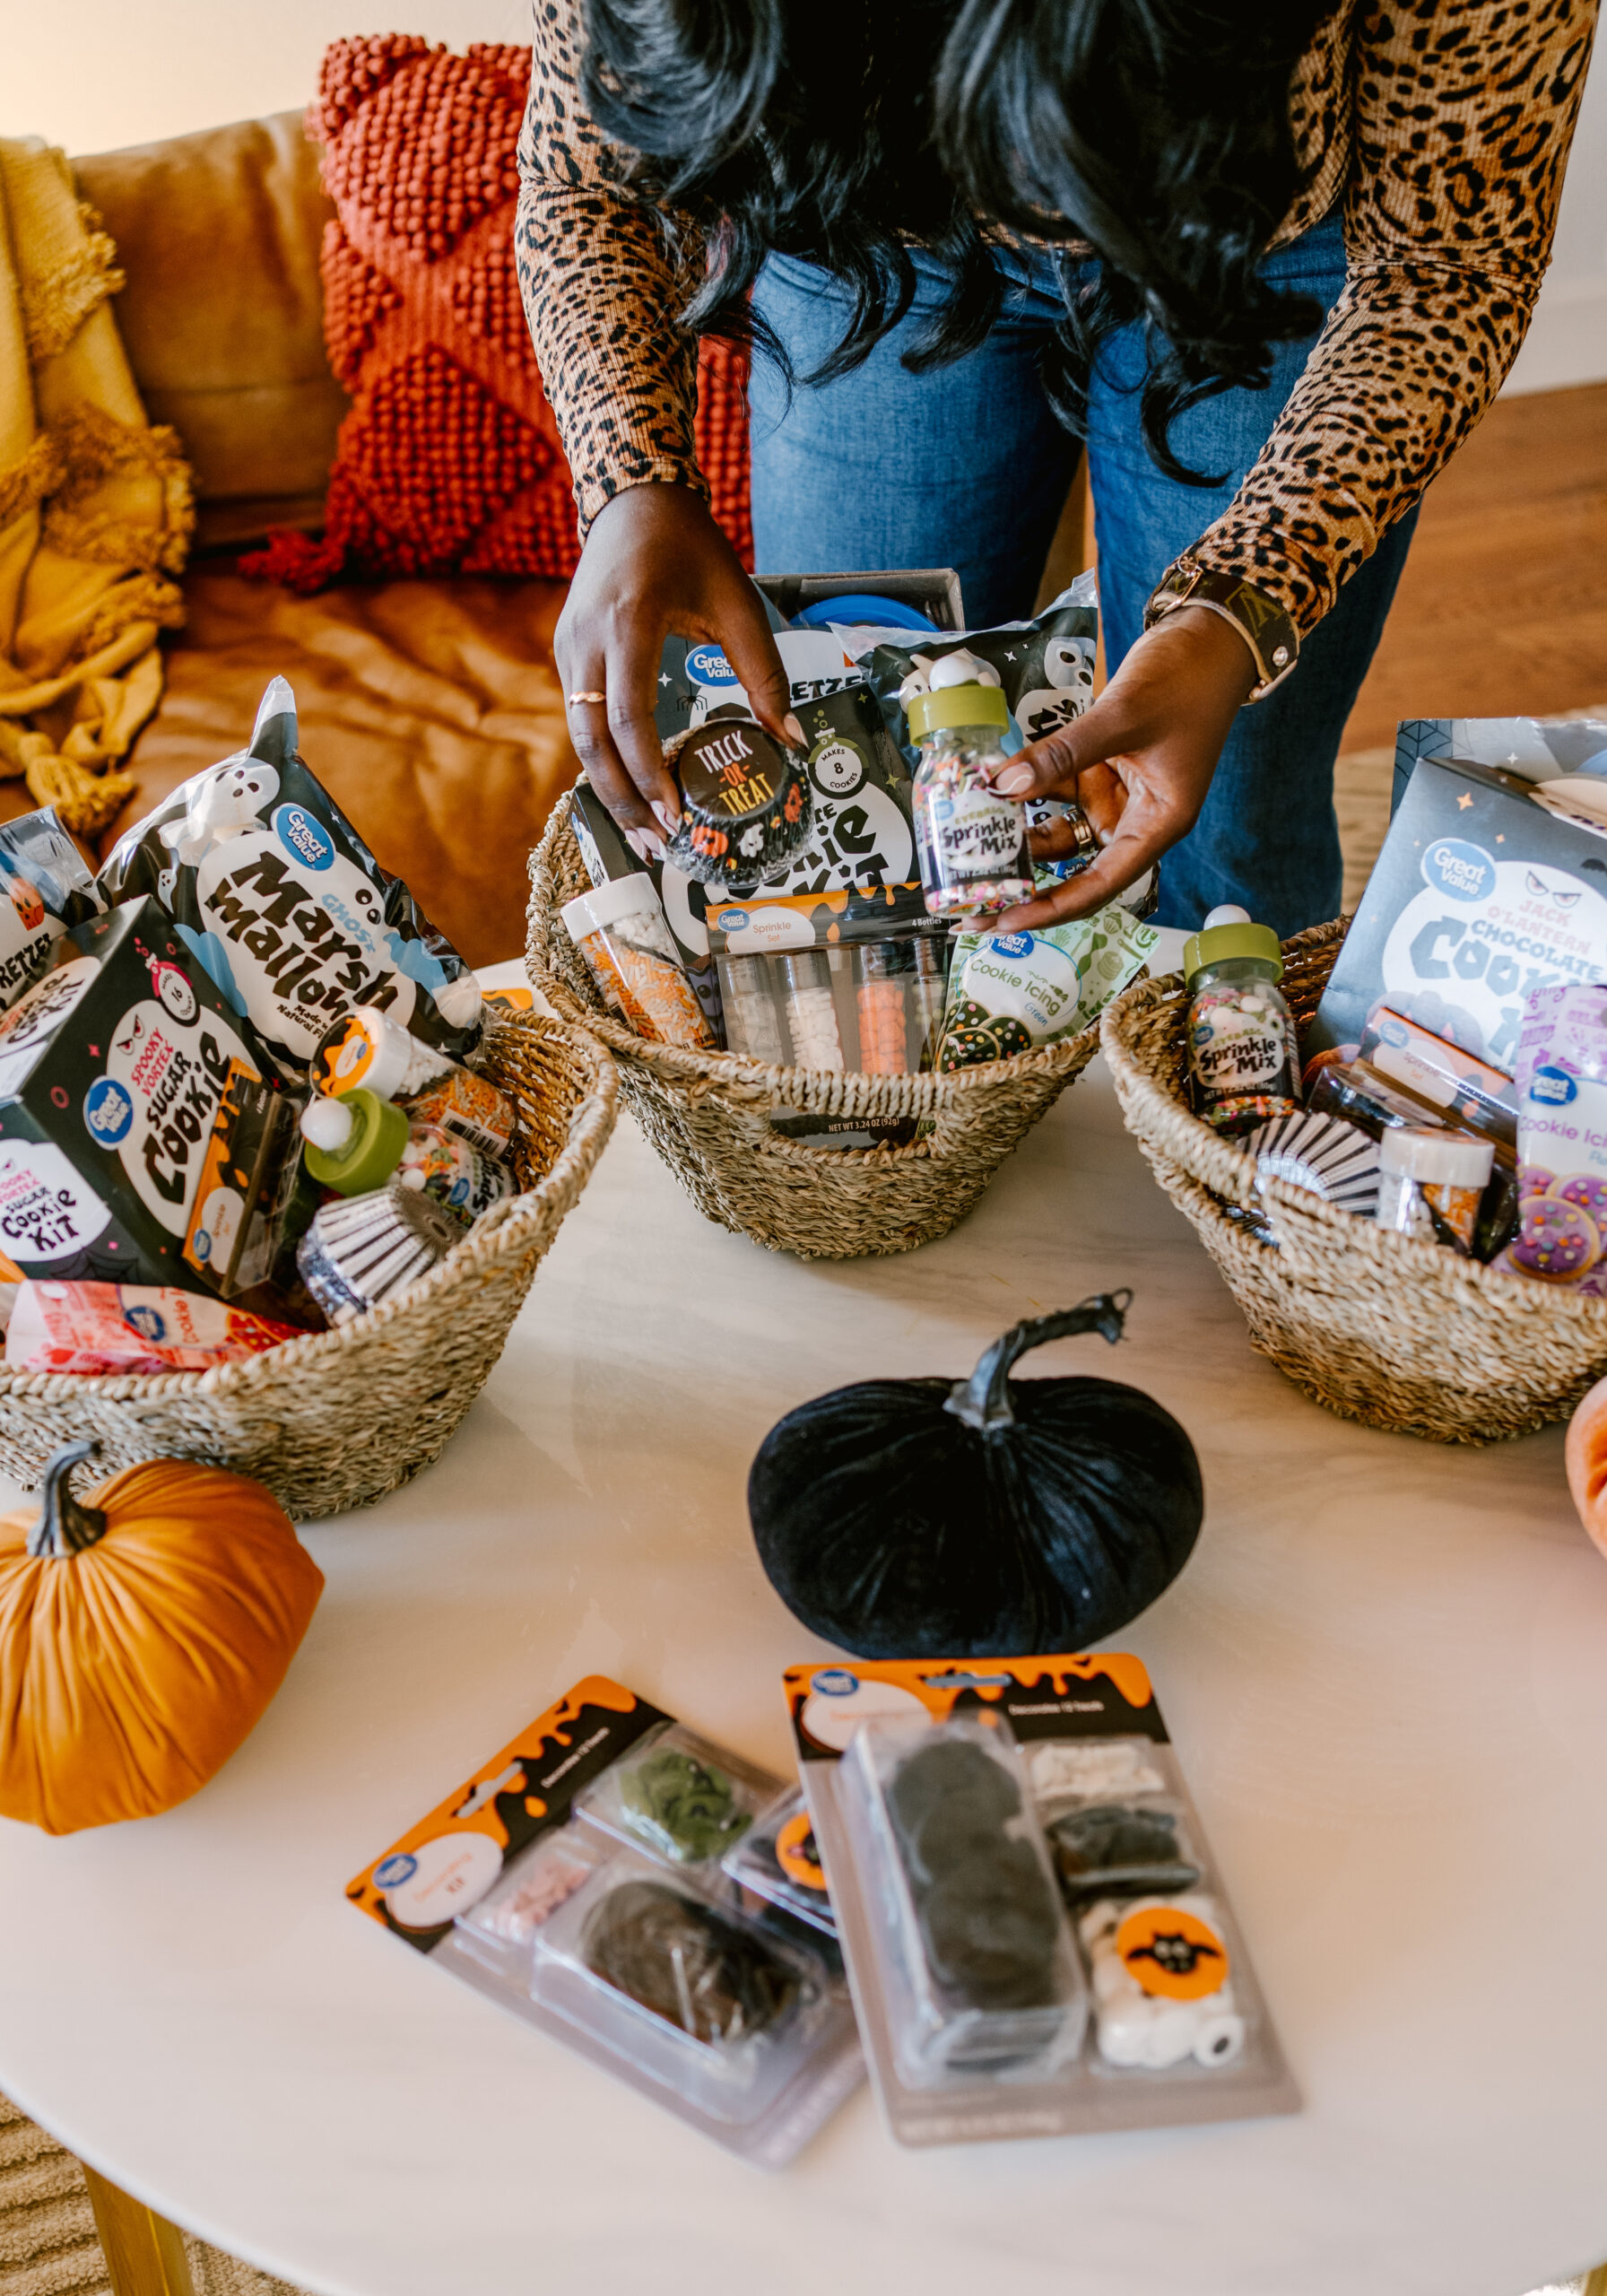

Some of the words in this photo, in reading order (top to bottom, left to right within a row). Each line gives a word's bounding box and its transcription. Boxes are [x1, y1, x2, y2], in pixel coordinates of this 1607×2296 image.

[706, 666, 736, 678] Valu
[694, 730, 753, 774] TRICK
[821, 749, 846, 761] MAKES
[830, 772, 858, 789] COOKIES
[834, 762, 844, 774] 8
[718, 772, 776, 816] TREAT
[287, 827, 317, 864] Value
[288, 811, 328, 858] Great
[942, 816, 1016, 848] Sprinkle
[980, 835, 1018, 855] Mix
[1434, 847, 1487, 884] Great
[1441, 866, 1480, 894] Value
[721, 914, 744, 924] Great
[917, 917, 942, 926] Bottles
[1519, 900, 1571, 927] JACK
[230, 850, 400, 1013] Marsh
[753, 921, 791, 935] Sprinkle
[767, 934, 780, 943] Set
[997, 938, 1021, 954] Value
[1472, 919, 1603, 981] CHOCOLATE
[171, 987, 182, 1002] 16
[970, 959, 1022, 987] Cookie
[1024, 980, 1061, 1016] Icing
[276, 1004, 315, 1031] Natural
[294, 1004, 322, 1024] Made
[1024, 1002, 1048, 1027] Green
[131, 1027, 165, 1086] SPOOKY
[1200, 1037, 1276, 1071] Sprinkle
[1236, 1053, 1277, 1074] Mix
[141, 1039, 174, 1098] VORTEX
[146, 1050, 192, 1131] SUGAR
[142, 1031, 231, 1205] Cookie
[829, 1124, 841, 1132] NET
[842, 1121, 854, 1131] WT
[855, 1119, 870, 1129] 3.24
[871, 1118, 881, 1126] OZ
[882, 1117, 899, 1126] (92g)
[2, 1189, 77, 1239] Cookie
